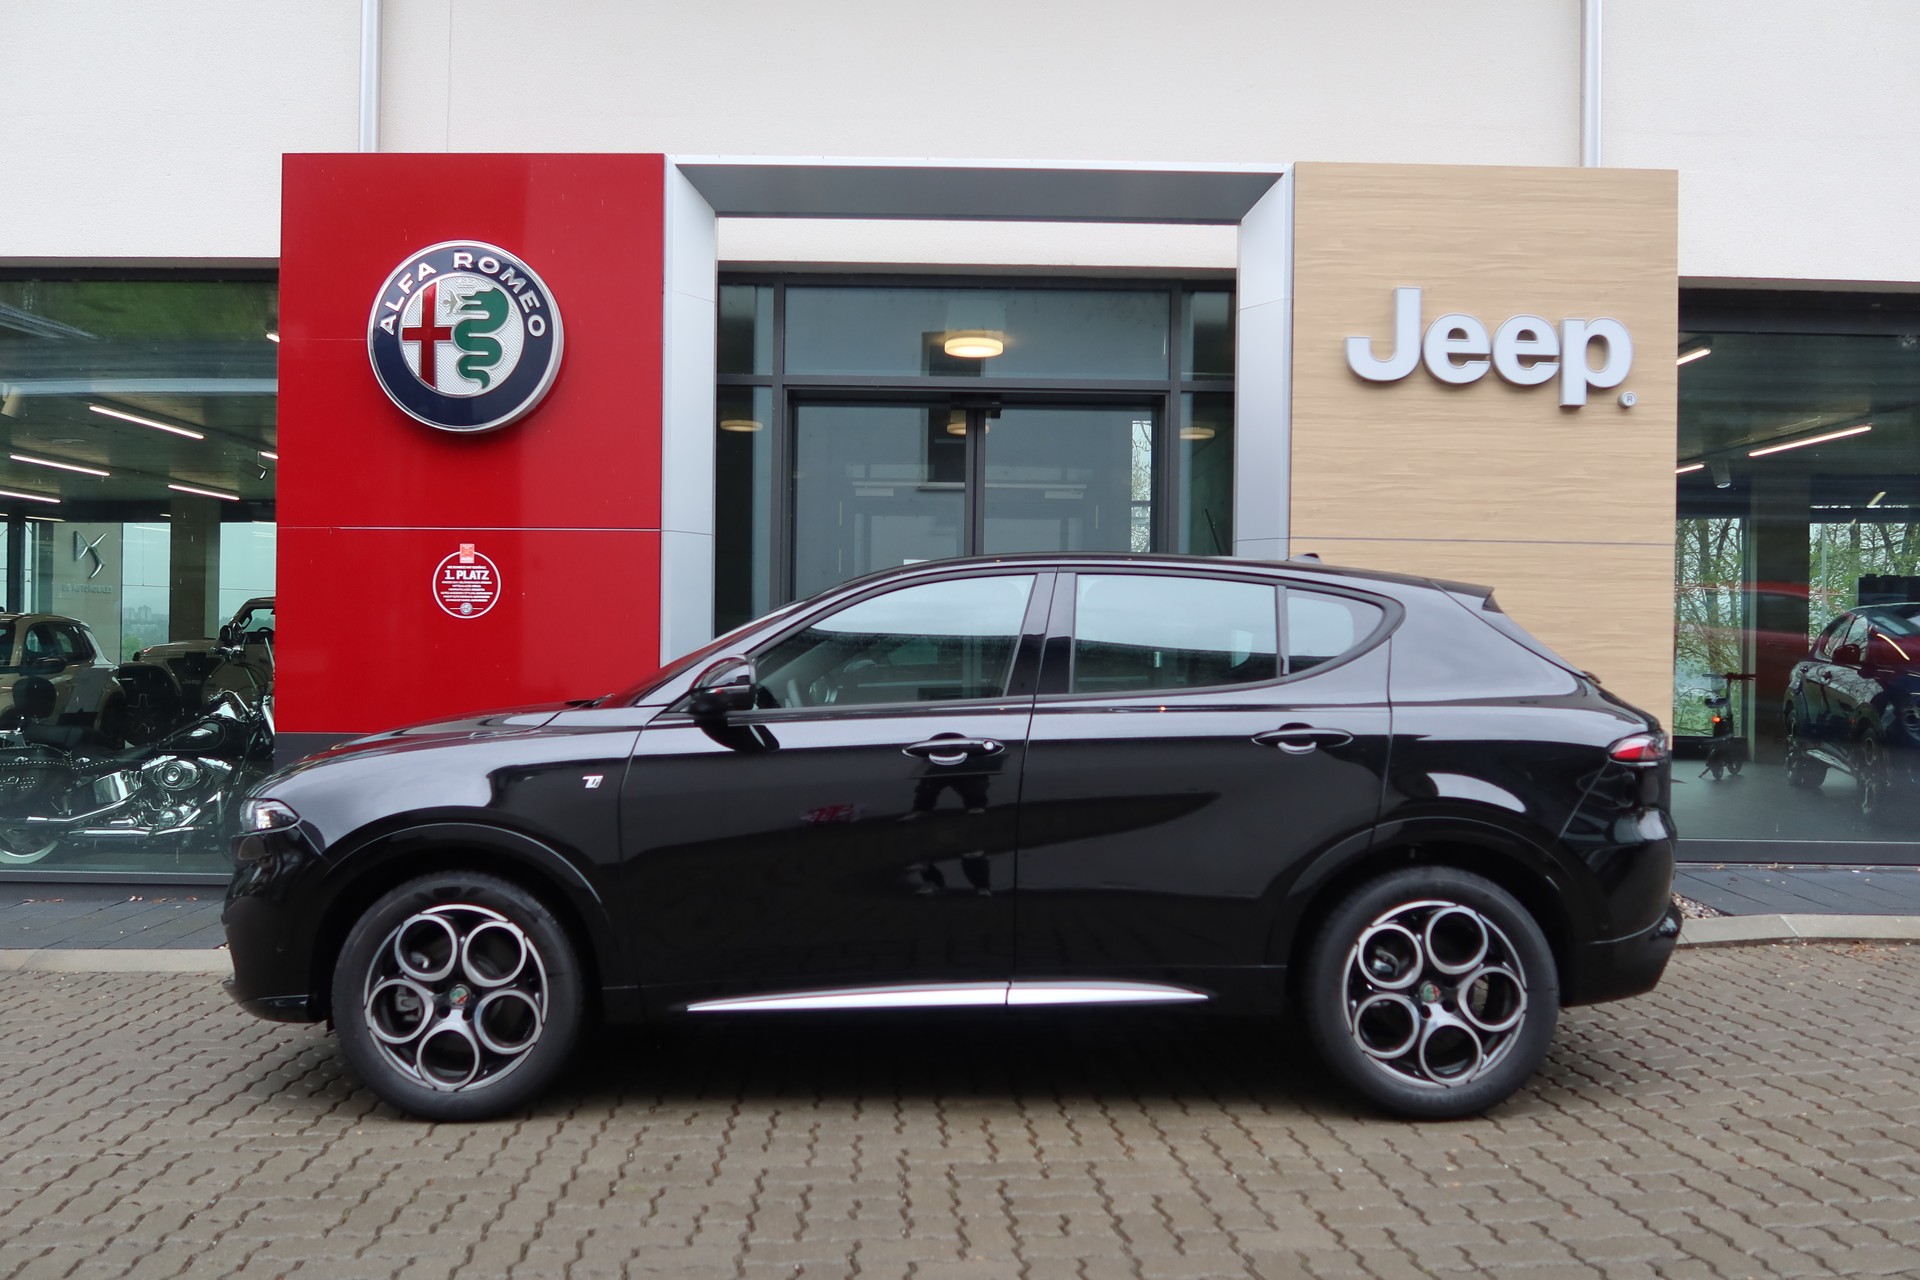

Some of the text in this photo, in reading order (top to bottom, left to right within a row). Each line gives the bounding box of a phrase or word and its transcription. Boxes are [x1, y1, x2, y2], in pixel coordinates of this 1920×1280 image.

[379, 252, 546, 337] ALFA ROMEO
[1345, 286, 1633, 409] Jeep
[444, 570, 490, 580] 1. PLATZ
